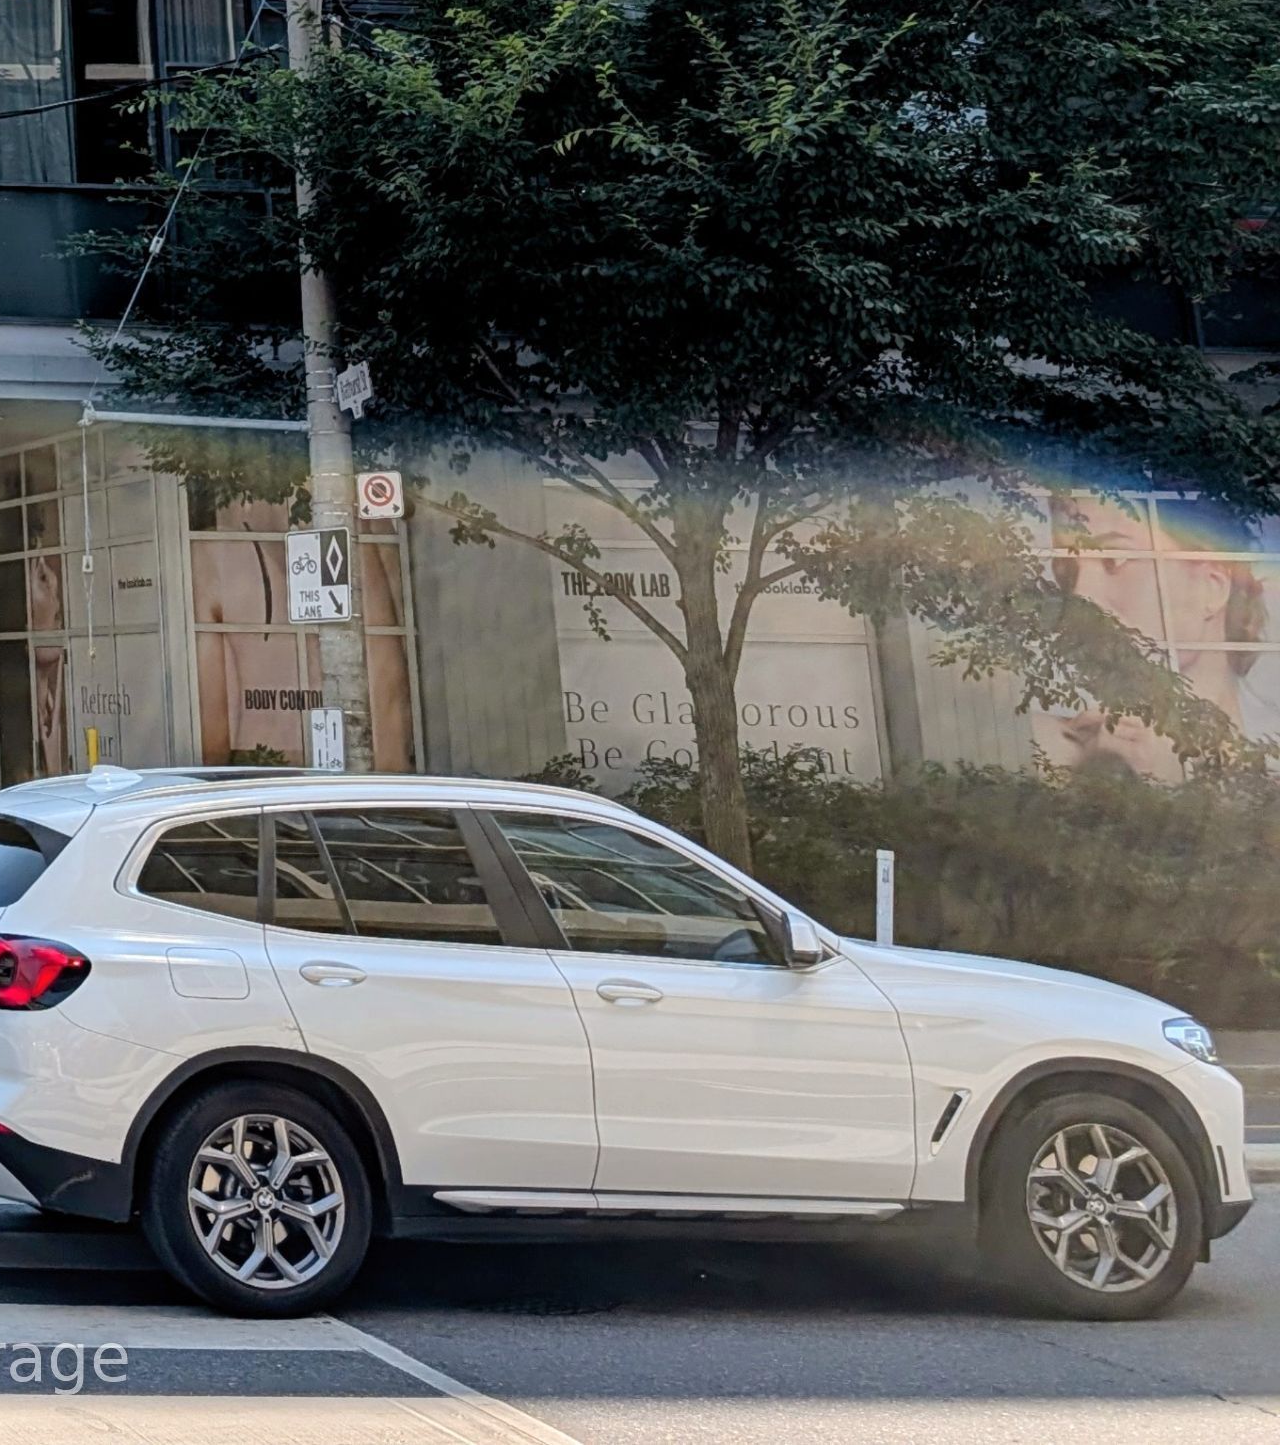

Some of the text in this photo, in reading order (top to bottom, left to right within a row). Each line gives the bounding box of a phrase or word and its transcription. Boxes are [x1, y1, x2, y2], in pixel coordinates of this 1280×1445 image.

[300, 590, 320, 602] THIS
[561, 572, 591, 596] THE
[640, 573, 671, 597] LAB
[298, 605, 322, 619] LANE
[80, 683, 131, 717] Refresh
[245, 689, 277, 711] BODY
[563, 691, 860, 729] Be Glaorous
[578, 738, 622, 770] Be
